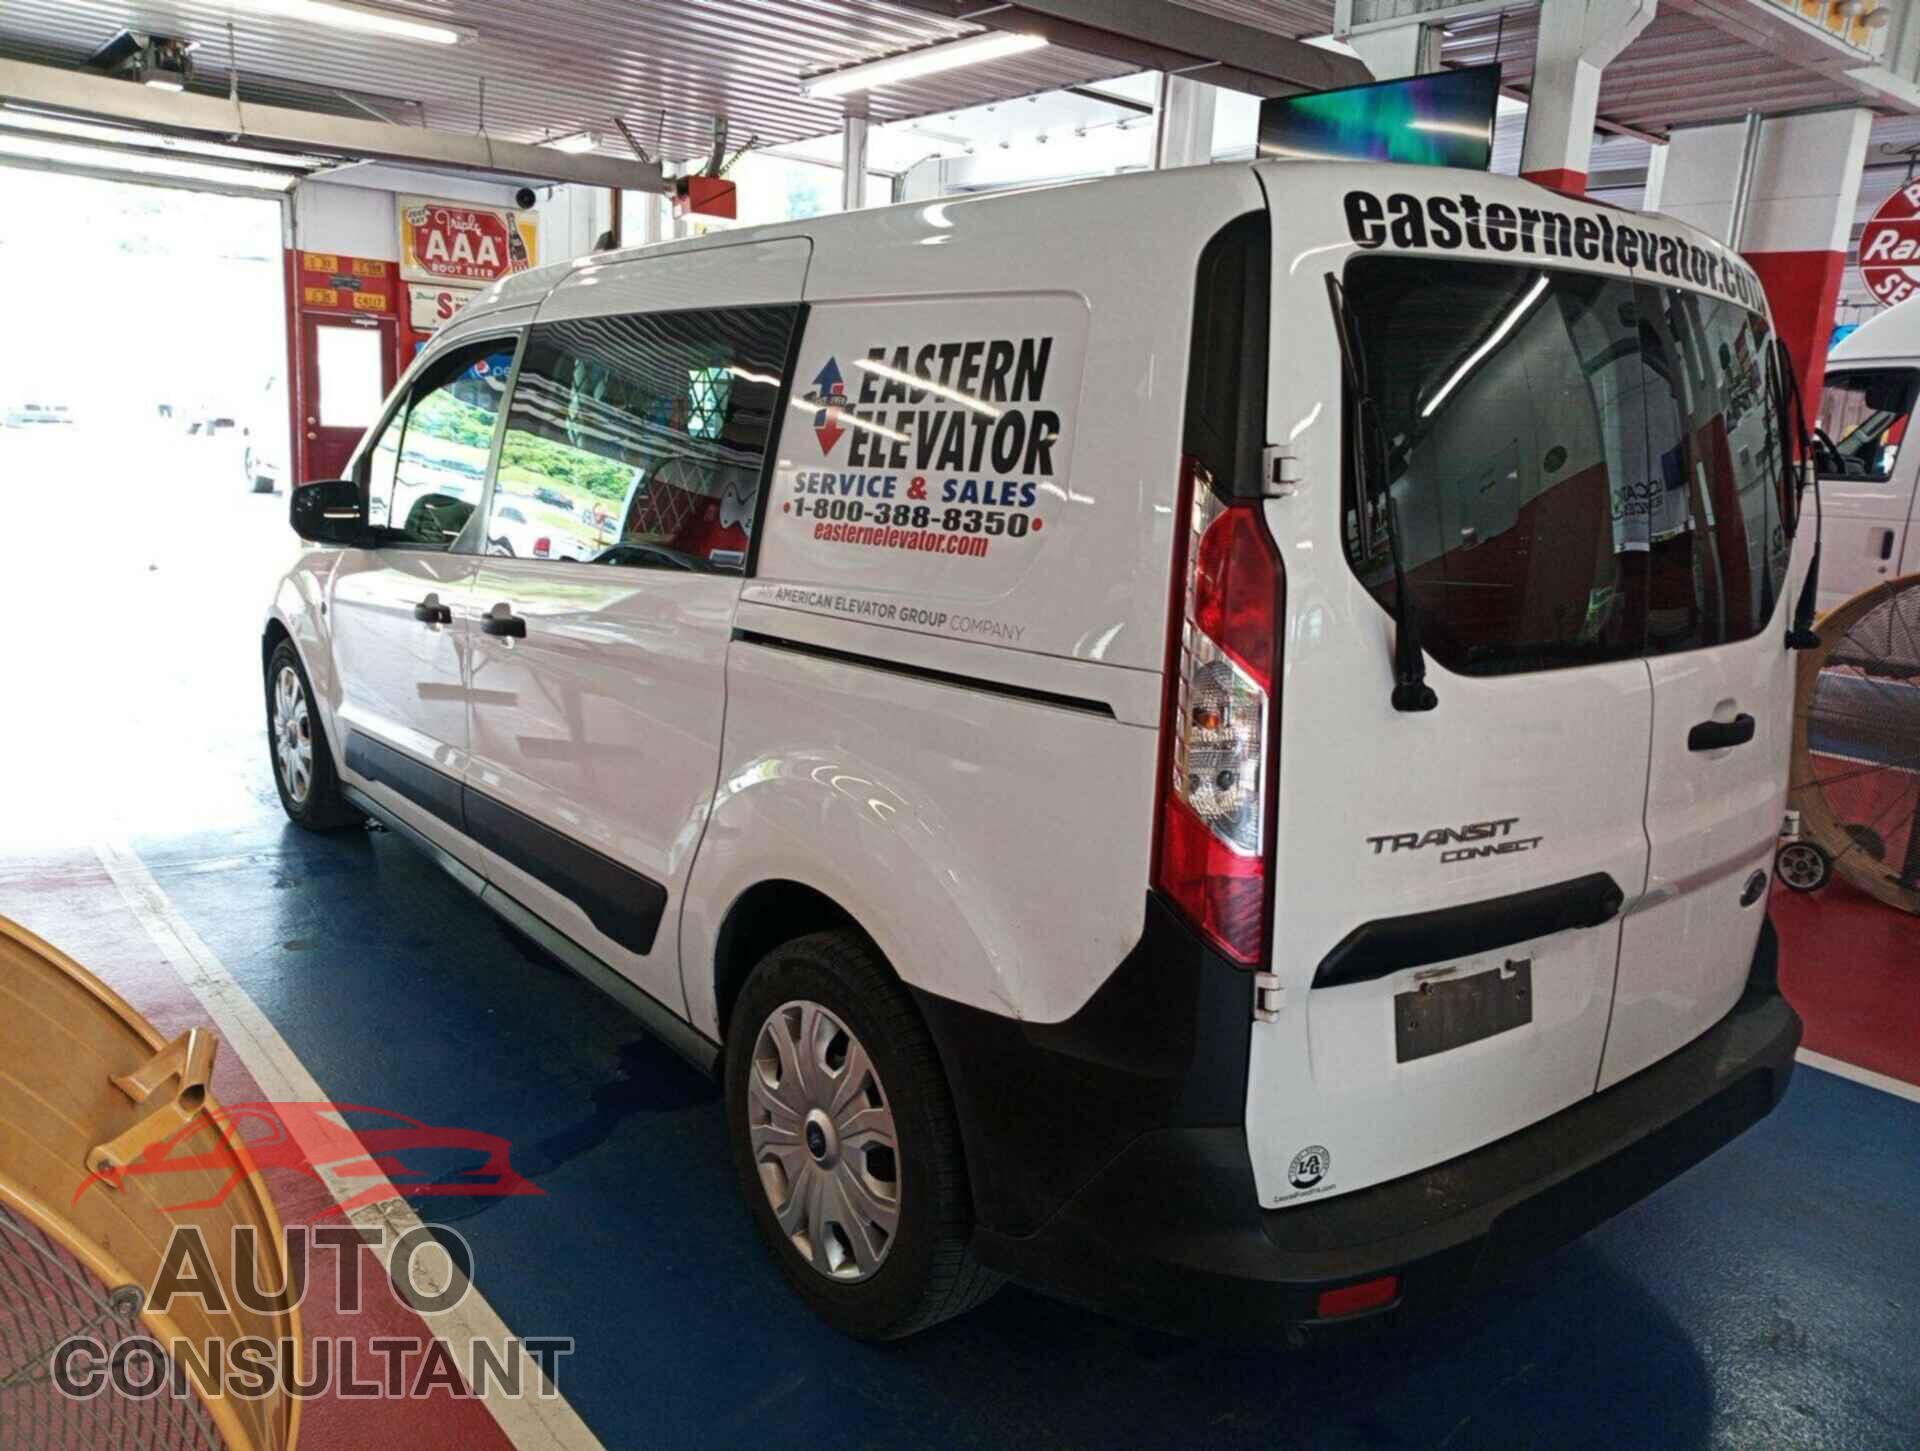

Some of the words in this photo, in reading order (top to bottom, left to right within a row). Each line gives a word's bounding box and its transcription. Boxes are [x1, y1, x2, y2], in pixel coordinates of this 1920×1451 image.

[435, 209, 481, 236] Triple
[1343, 190, 1767, 318] easternelevator.com
[1863, 229, 1920, 260] Ra
[431, 263, 462, 274] ROOT
[466, 267, 494, 278] BEER
[1874, 273, 1914, 304] SE
[859, 337, 1053, 404] EASTERN
[848, 409, 1061, 476] ELEVATOR
[794, 472, 898, 499] SERVICE
[907, 476, 928, 501] &
[941, 478, 1037, 508] SALES
[794, 498, 1030, 538] 1-800-388-8350
[814, 521, 989, 558] easternelevator.com
[775, 588, 833, 609] AMERICAN
[834, 596, 897, 621] ELEVATOR
[899, 606, 947, 628] GROUP
[950, 614, 1027, 641] COMPANY
[1366, 817, 1520, 854] TRANSIT
[1440, 836, 1543, 864] CONNECT
